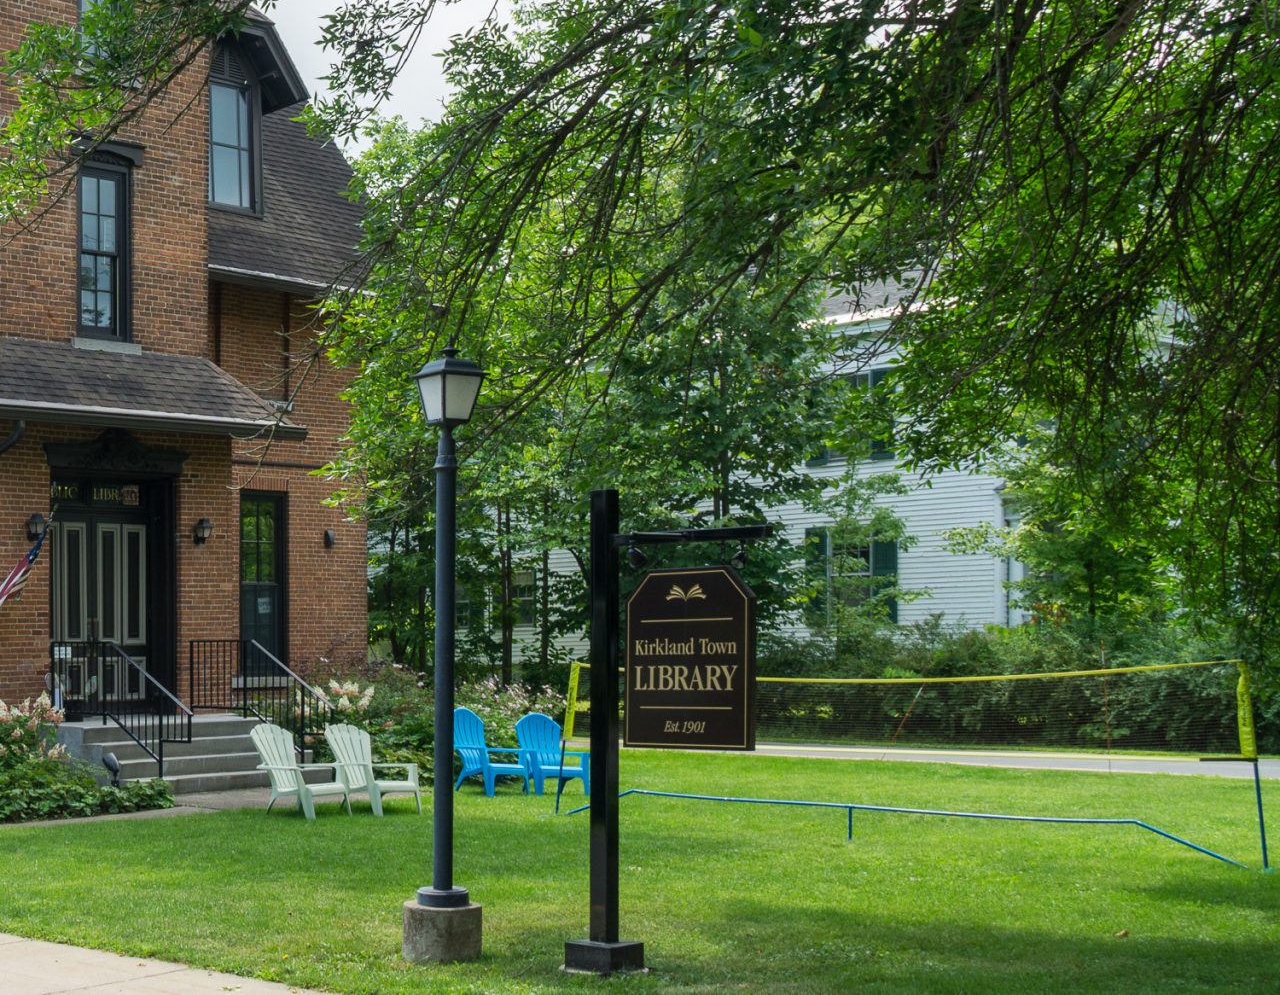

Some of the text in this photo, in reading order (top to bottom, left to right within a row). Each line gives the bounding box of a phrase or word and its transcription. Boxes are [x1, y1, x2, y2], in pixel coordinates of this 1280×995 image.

[634, 637, 737, 656] Kirkland Town
[634, 664, 738, 691] LIBRARY
[663, 720, 706, 734] Est. 1901
